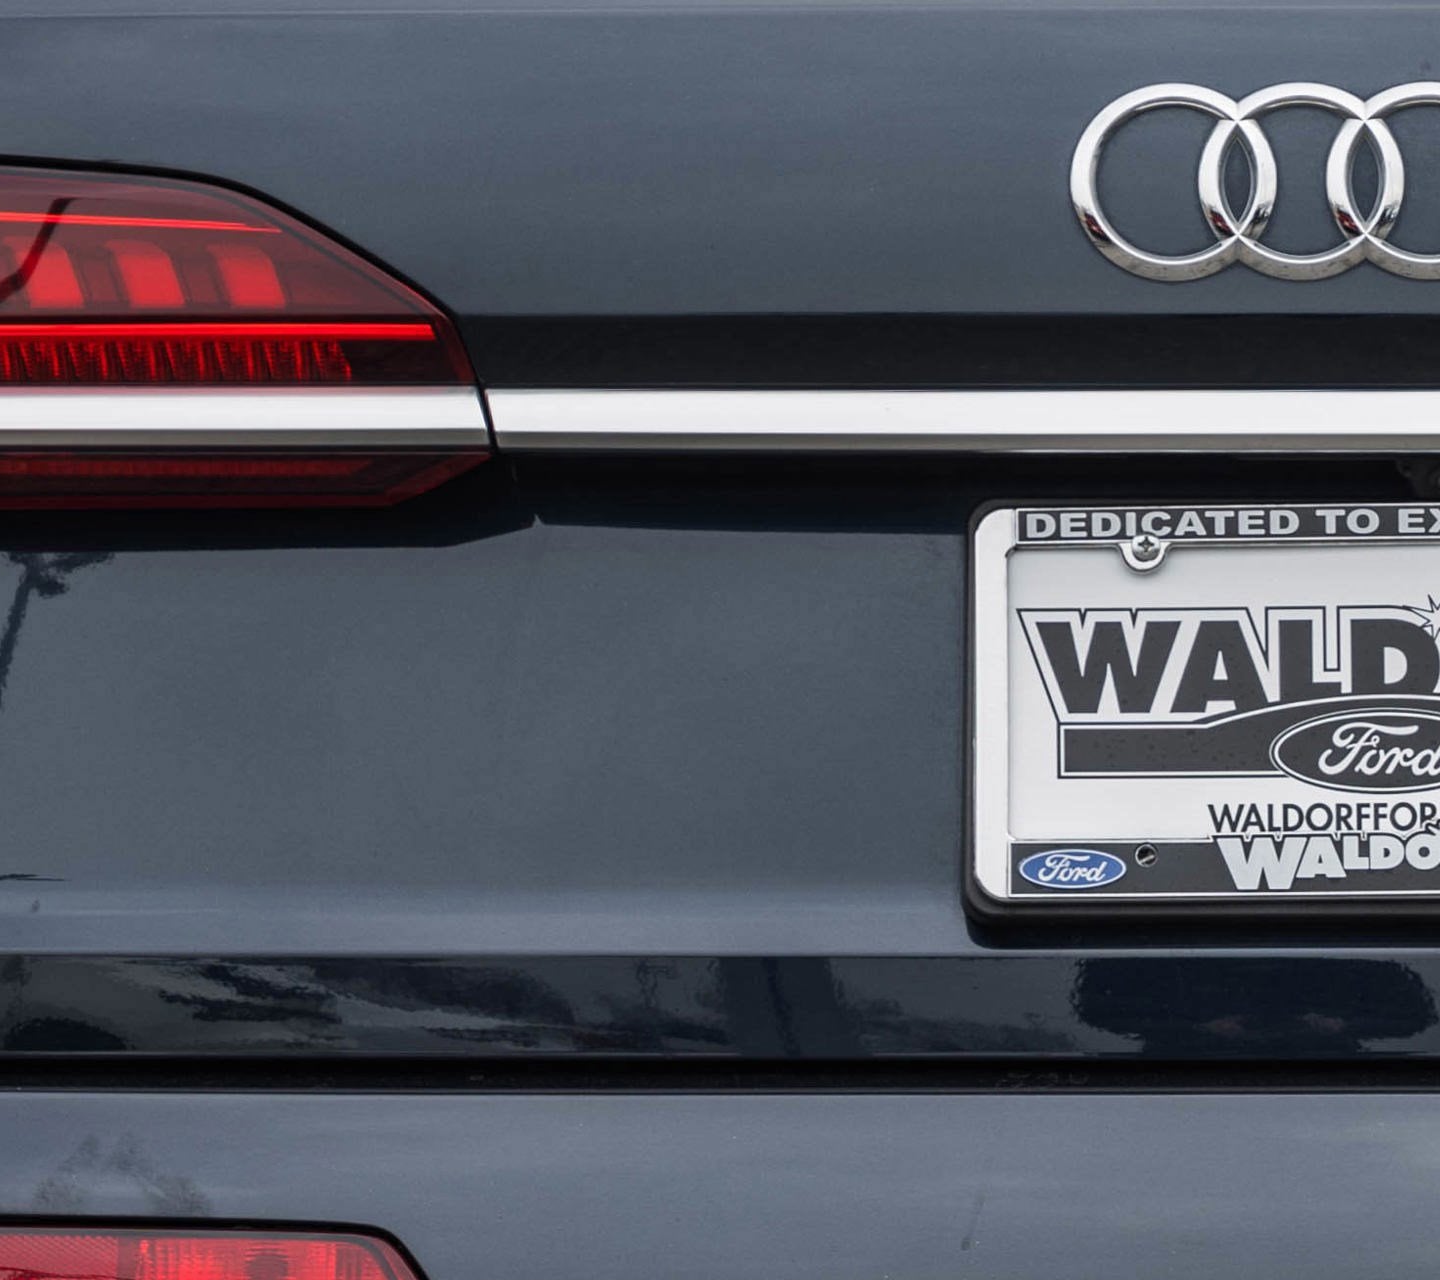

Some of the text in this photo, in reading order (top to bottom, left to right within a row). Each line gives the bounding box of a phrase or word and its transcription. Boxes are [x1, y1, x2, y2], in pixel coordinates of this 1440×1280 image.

[1025, 509, 1301, 539] DEDICATED
[1314, 508, 1381, 534] TO
[1037, 850, 1107, 884] Ford
